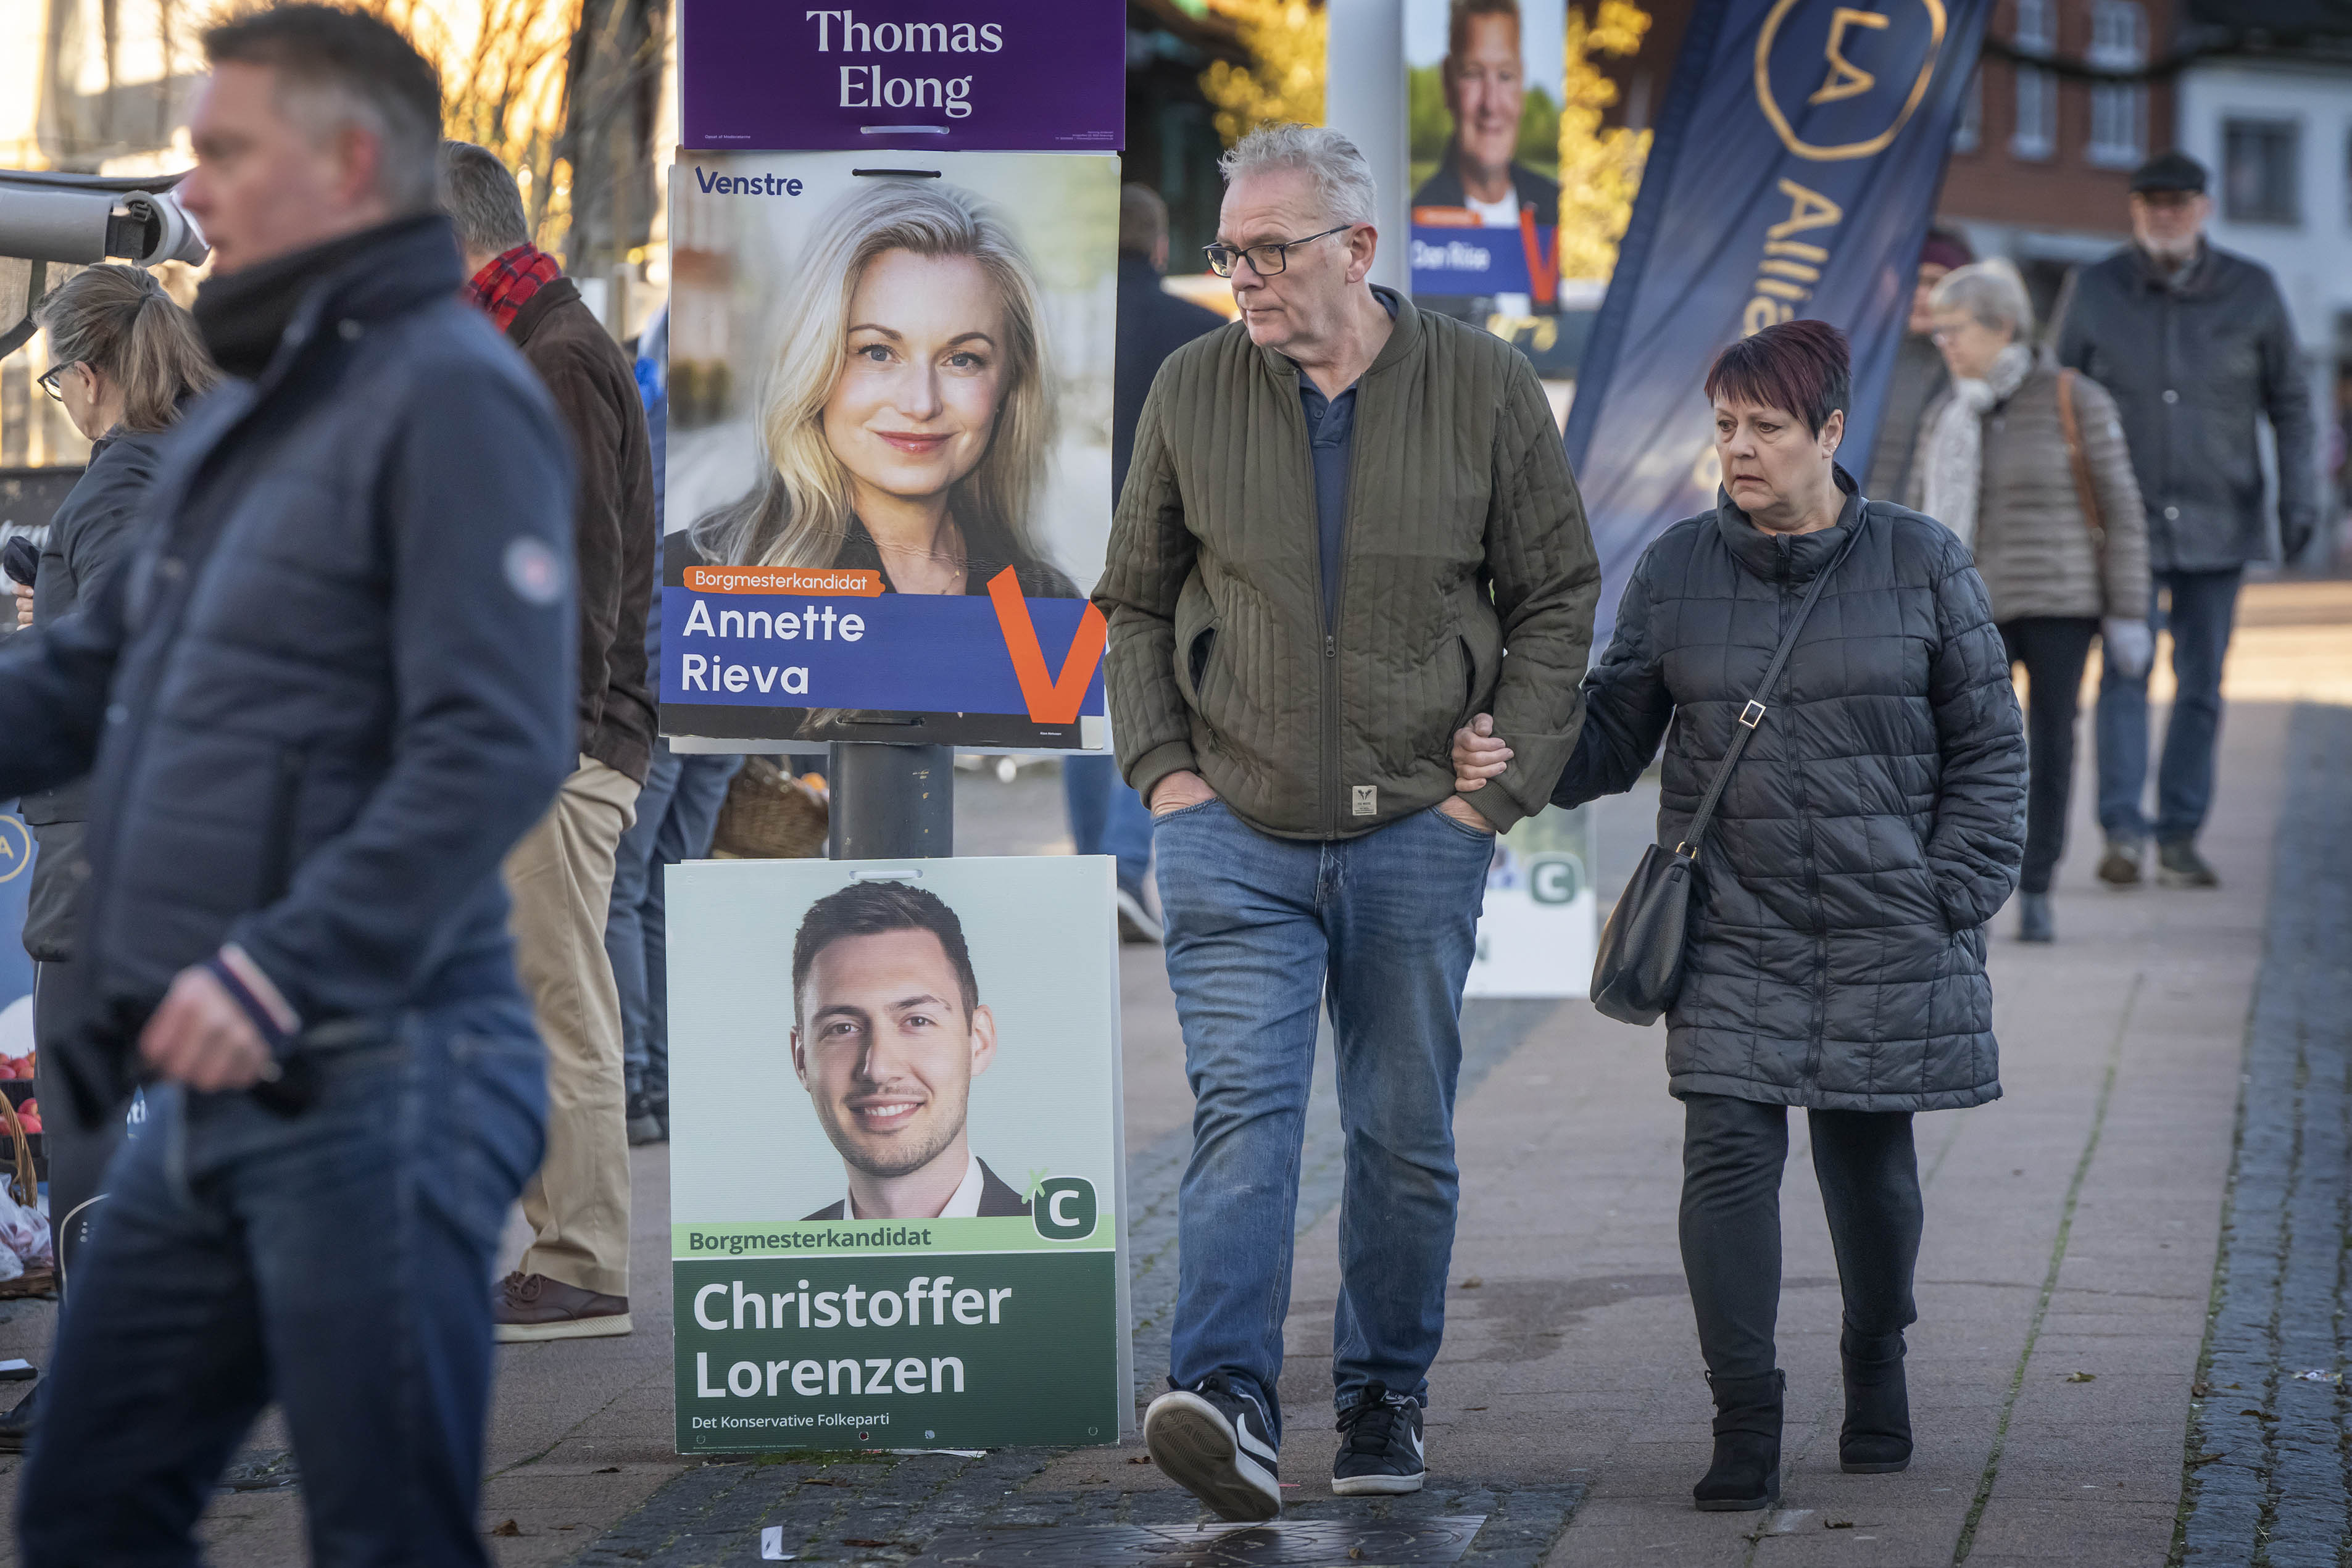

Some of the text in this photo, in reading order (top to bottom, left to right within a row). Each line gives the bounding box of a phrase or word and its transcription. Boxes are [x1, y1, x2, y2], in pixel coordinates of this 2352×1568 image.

[806, 9, 1003, 52] Thomas
[1808, 7, 1890, 105] LA
[839, 65, 973, 118] Elong
[695, 165, 804, 196] Venstre
[695, 570, 868, 591] Borgmesterkandidat
[682, 599, 865, 642] Annette
[987, 565, 1108, 724] V
[682, 653, 808, 695] Rieva
[1537, 863, 1569, 900] C
[1049, 1190, 1080, 1227] C
[689, 1227, 932, 1255] Borgmesterkandidat
[694, 1276, 1012, 1330] Christoffer
[697, 1352, 965, 1398] Lorenzen
[692, 1413, 889, 1429] Det Konservative Folkeparti
